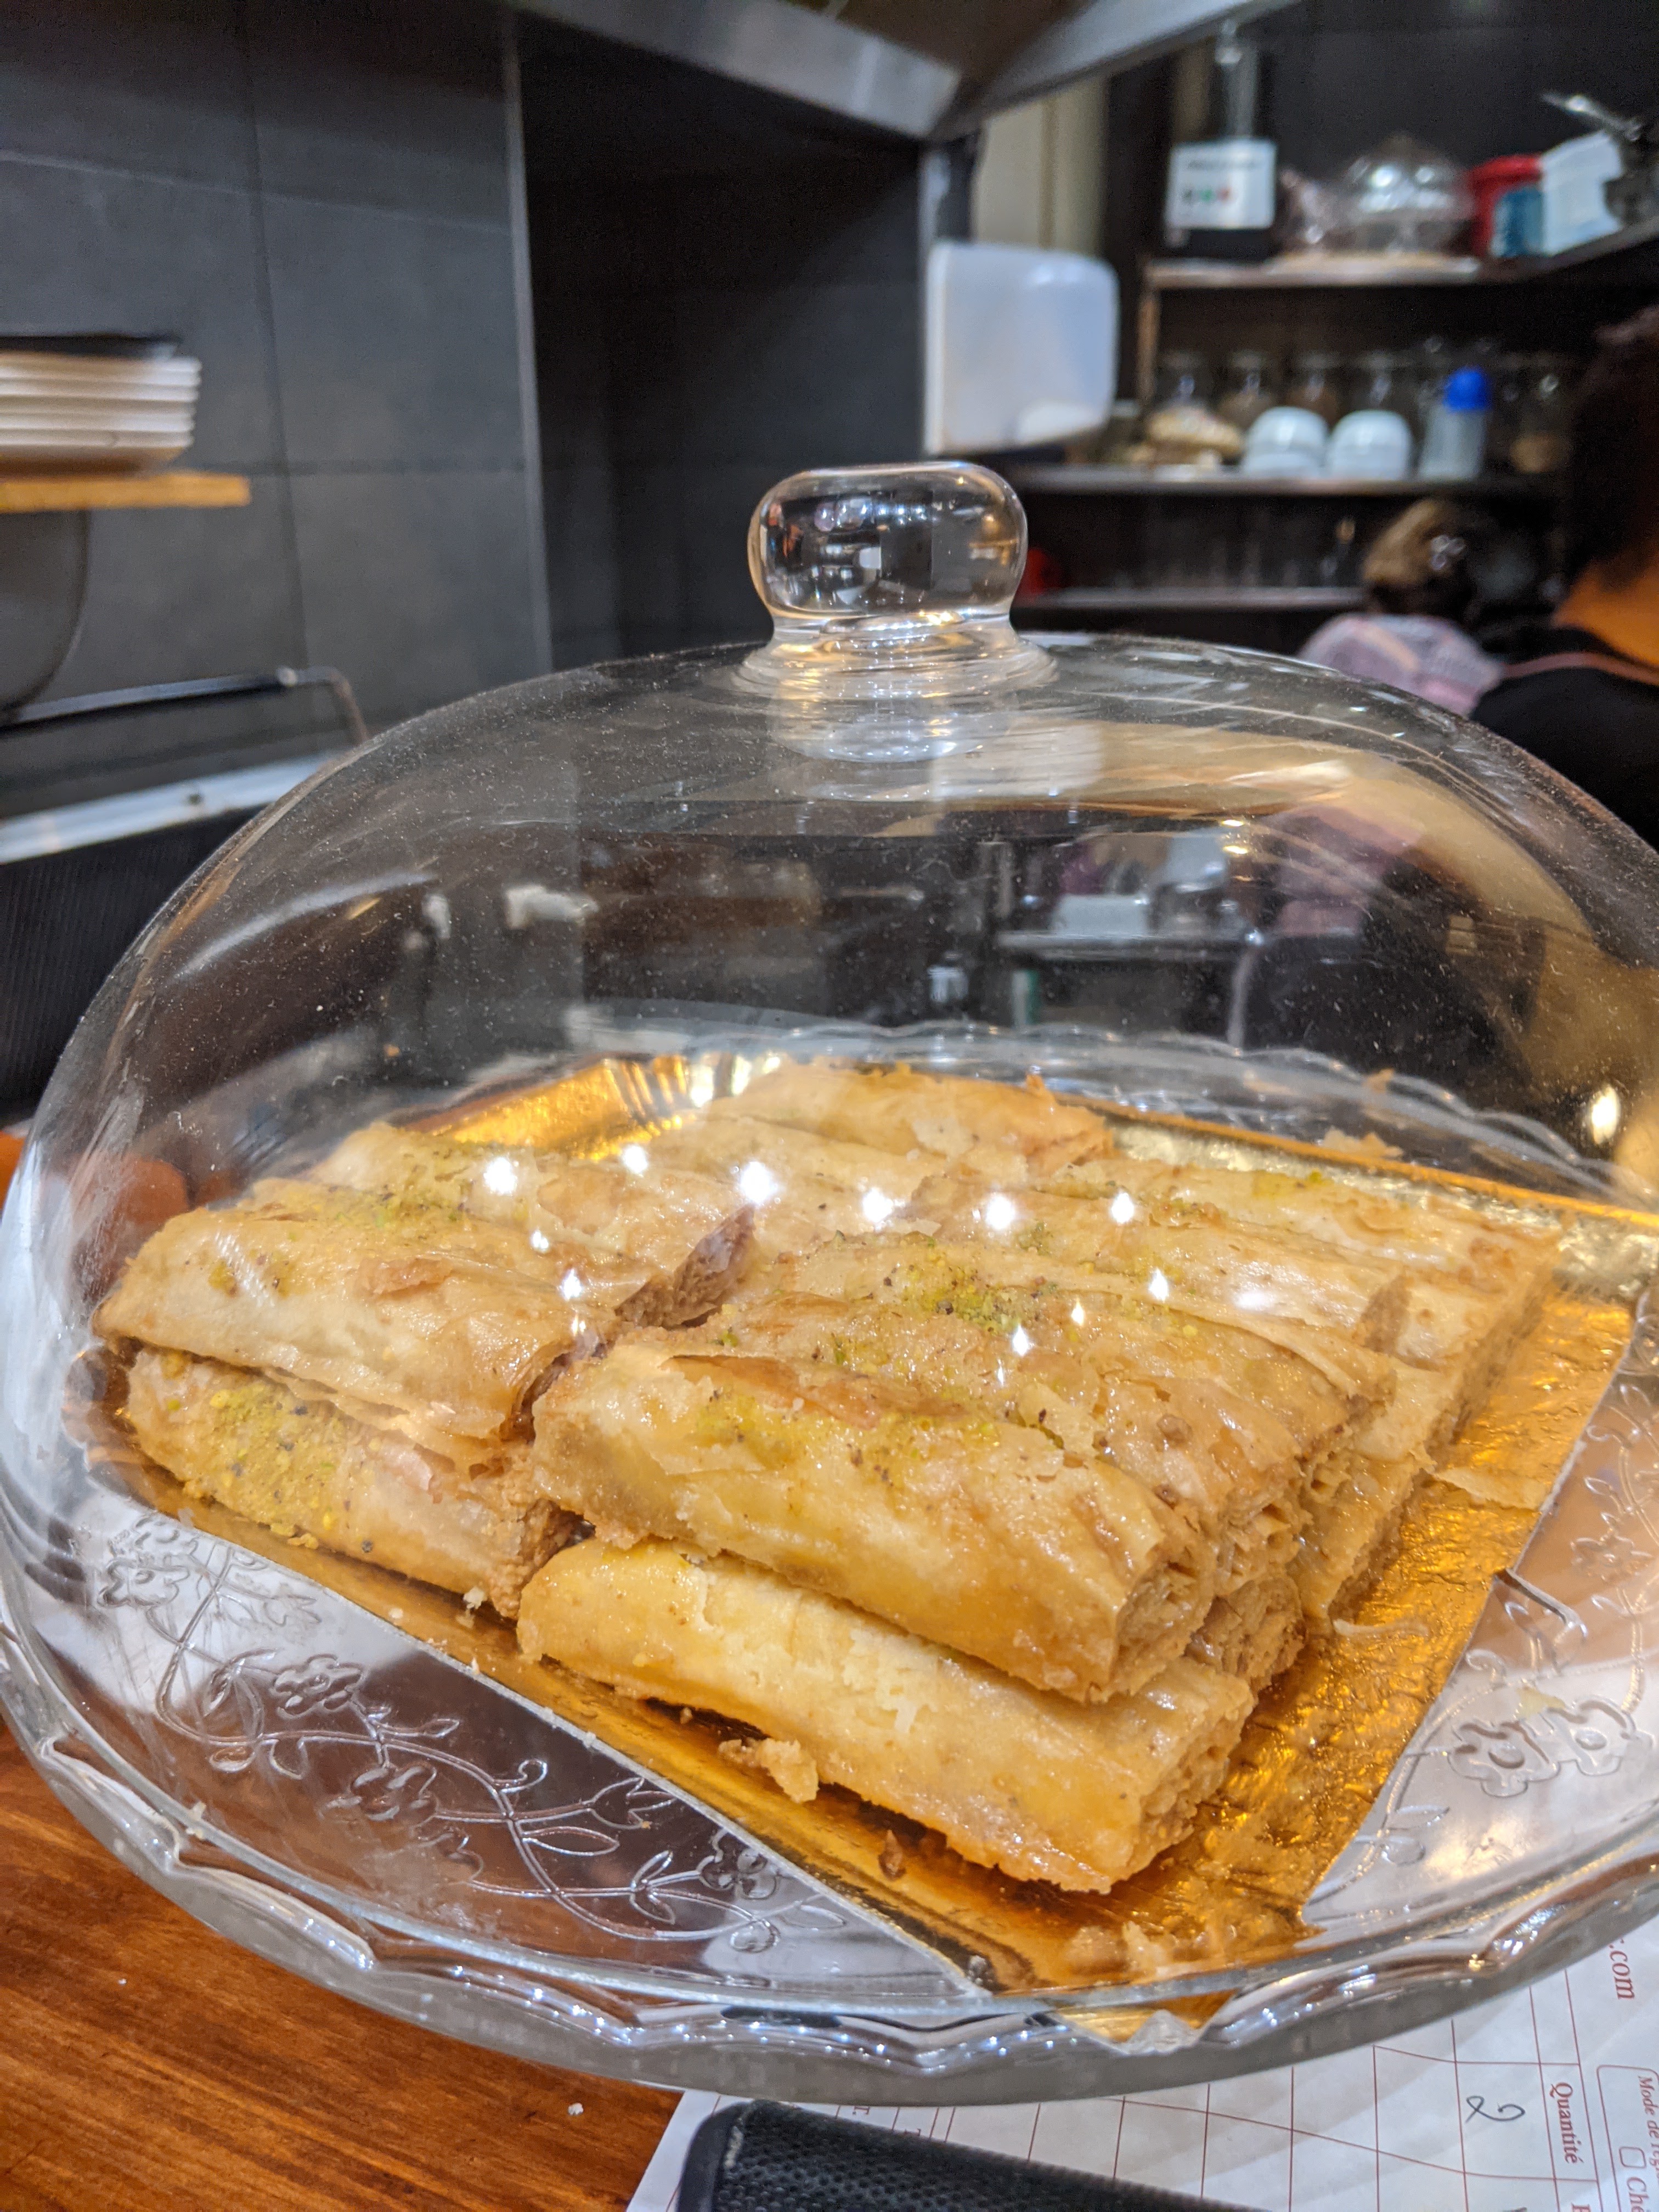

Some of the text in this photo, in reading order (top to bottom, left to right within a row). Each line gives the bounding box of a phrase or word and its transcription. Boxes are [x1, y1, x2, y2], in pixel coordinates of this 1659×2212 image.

[1609, 1938, 1635, 1999] .com
[1549, 2082, 1584, 2164] Quantité
[1638, 2075, 1659, 2115] Mode
